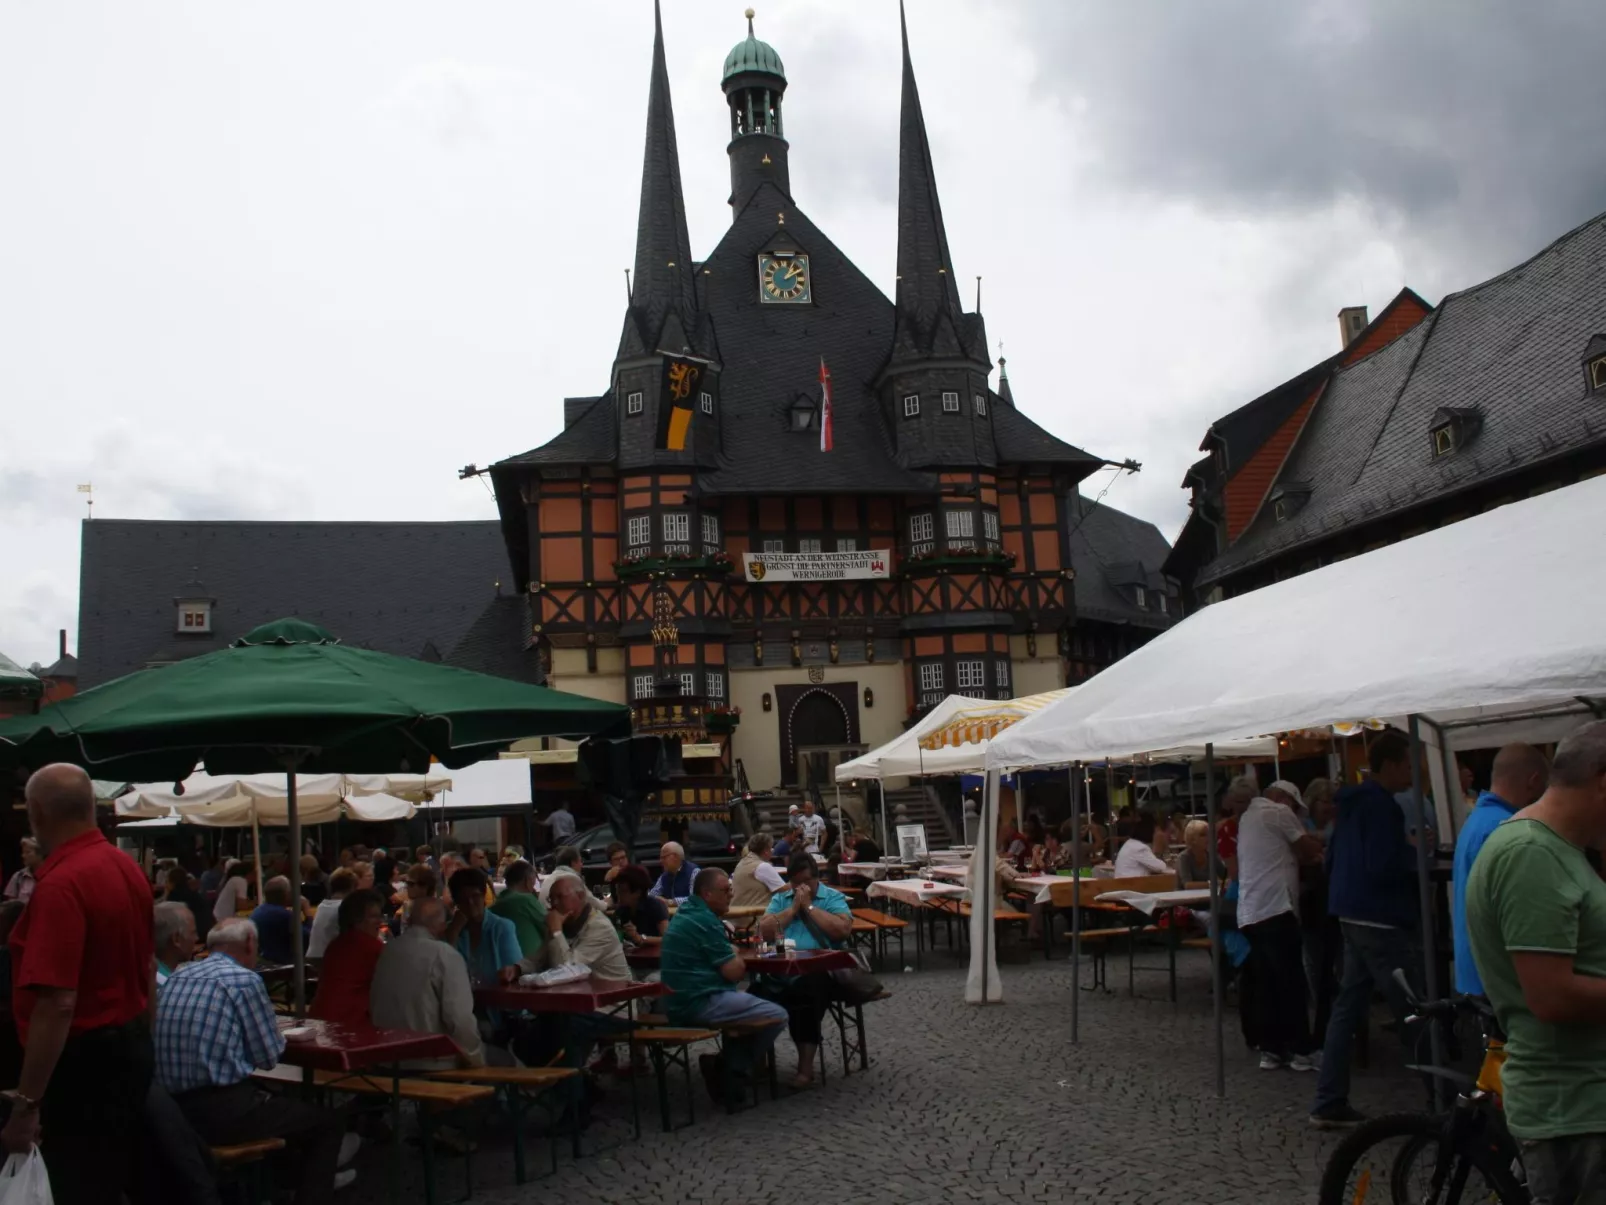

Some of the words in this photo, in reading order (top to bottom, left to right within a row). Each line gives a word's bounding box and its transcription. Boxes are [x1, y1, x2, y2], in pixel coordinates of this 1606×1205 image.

[754, 554, 794, 562] NEUSTADT
[795, 554, 806, 562] AN
[807, 554, 823, 562] DER
[825, 552, 880, 561] WEINSTRASSE
[797, 562, 809, 570] DIE
[811, 560, 868, 570] PARTNERSTADT
[792, 570, 846, 579] WERNIGERODE
